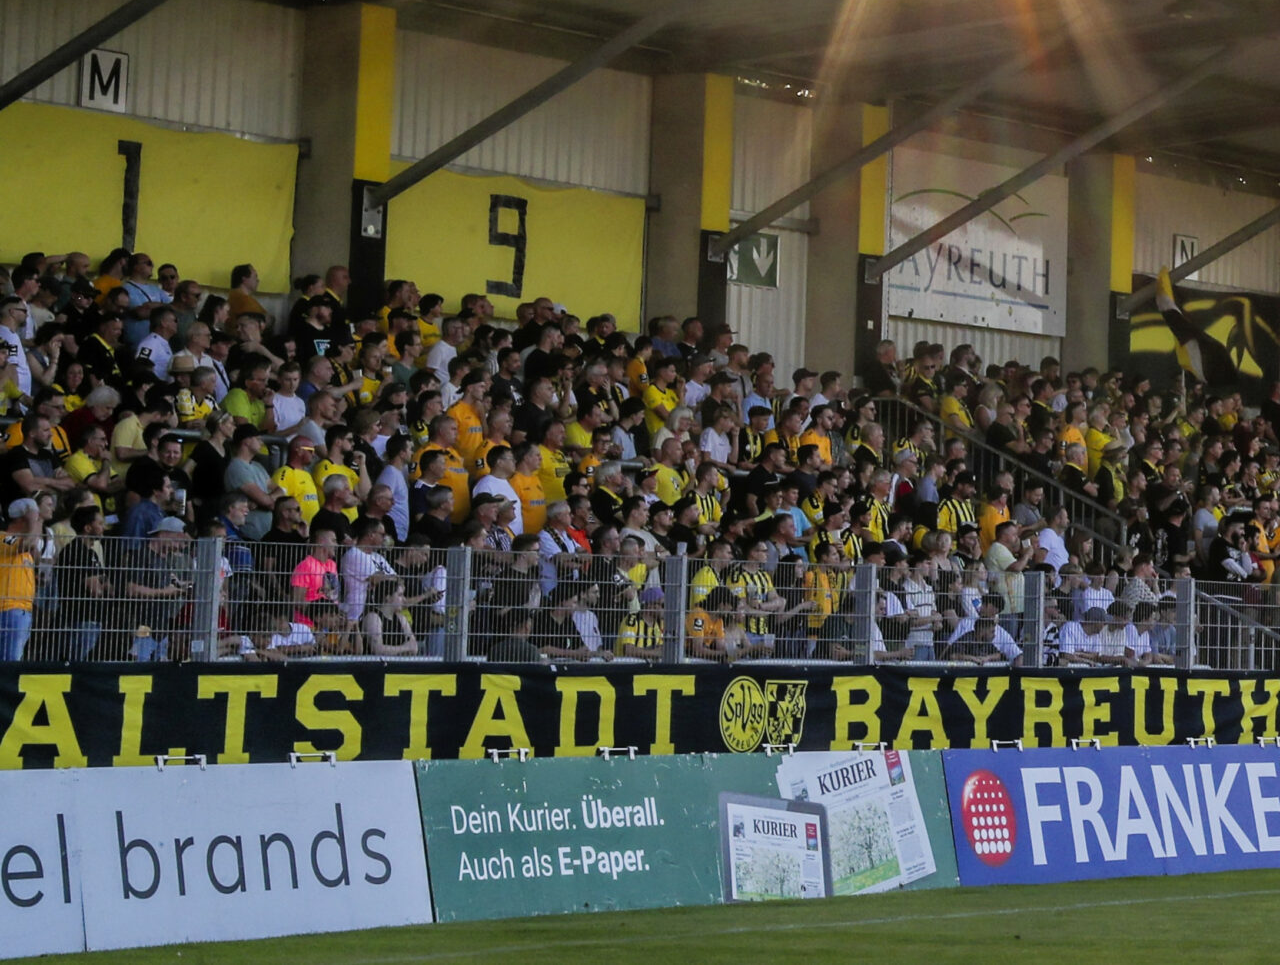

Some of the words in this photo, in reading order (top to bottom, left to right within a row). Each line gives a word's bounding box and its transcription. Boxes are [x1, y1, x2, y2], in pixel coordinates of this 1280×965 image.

[89, 53, 122, 105] M
[899, 241, 1050, 295] AYREUTH
[0, 673, 696, 769] ALTSTADT
[816, 758, 877, 796] KURIER
[451, 804, 503, 835] Dein
[507, 801, 578, 833] Kurier.
[581, 795, 666, 829] Überall.
[753, 818, 798, 839] KURIER
[115, 802, 392, 900] brands
[459, 849, 516, 882] Auch
[521, 846, 553, 878] als
[559, 845, 651, 880] E-Paper.
